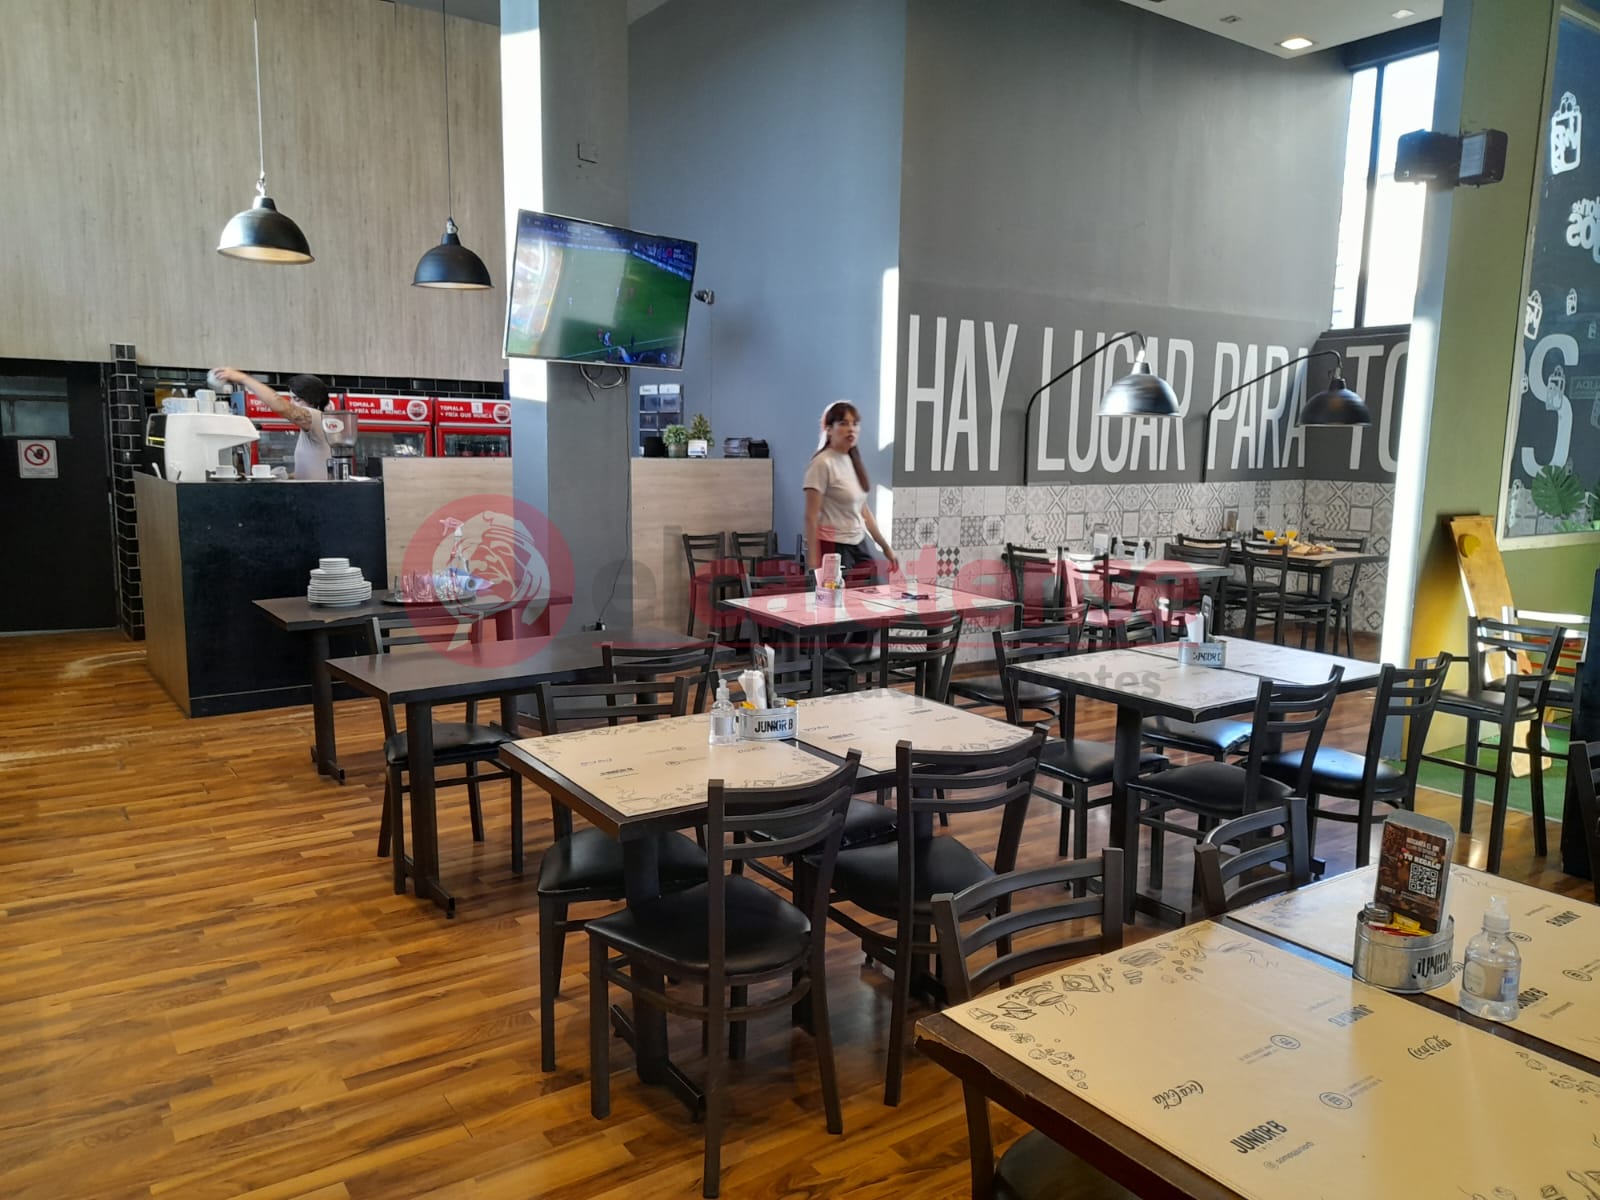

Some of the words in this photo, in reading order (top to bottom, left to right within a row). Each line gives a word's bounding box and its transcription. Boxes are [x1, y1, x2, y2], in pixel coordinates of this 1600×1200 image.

[905, 315, 1018, 472] HAY
[1207, 341, 1308, 470] PARA
[788, 718, 794, 730] B
[1411, 950, 1451, 980] JUNIO
[1229, 1124, 1281, 1154] JUNIOR
[1265, 1119, 1288, 1134] B
